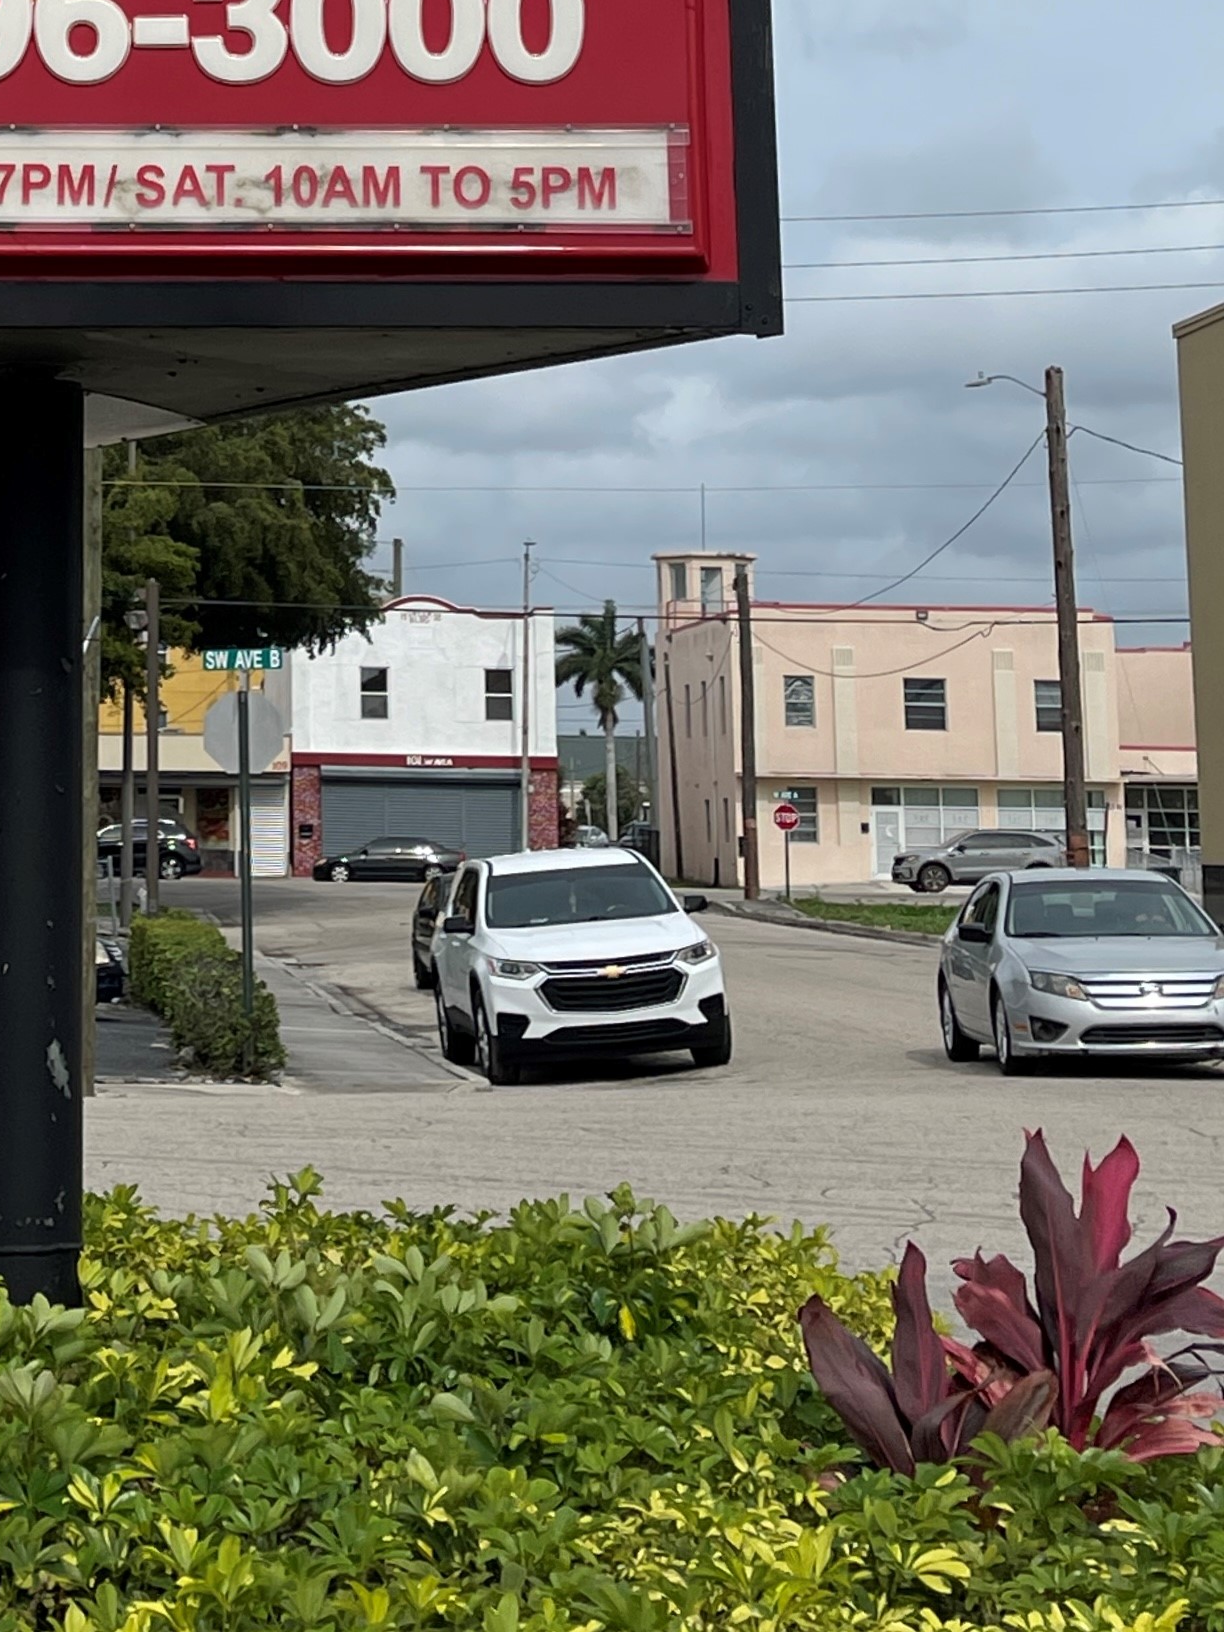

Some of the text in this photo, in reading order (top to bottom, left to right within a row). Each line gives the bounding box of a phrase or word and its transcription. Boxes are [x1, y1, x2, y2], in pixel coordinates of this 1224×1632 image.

[134, 163, 245, 208] SAT.
[263, 164, 403, 207] 10AM
[420, 164, 493, 209] TO
[510, 164, 618, 209] 5PM
[205, 648, 281, 669] SW AVE B
[775, 812, 798, 824] STOP
